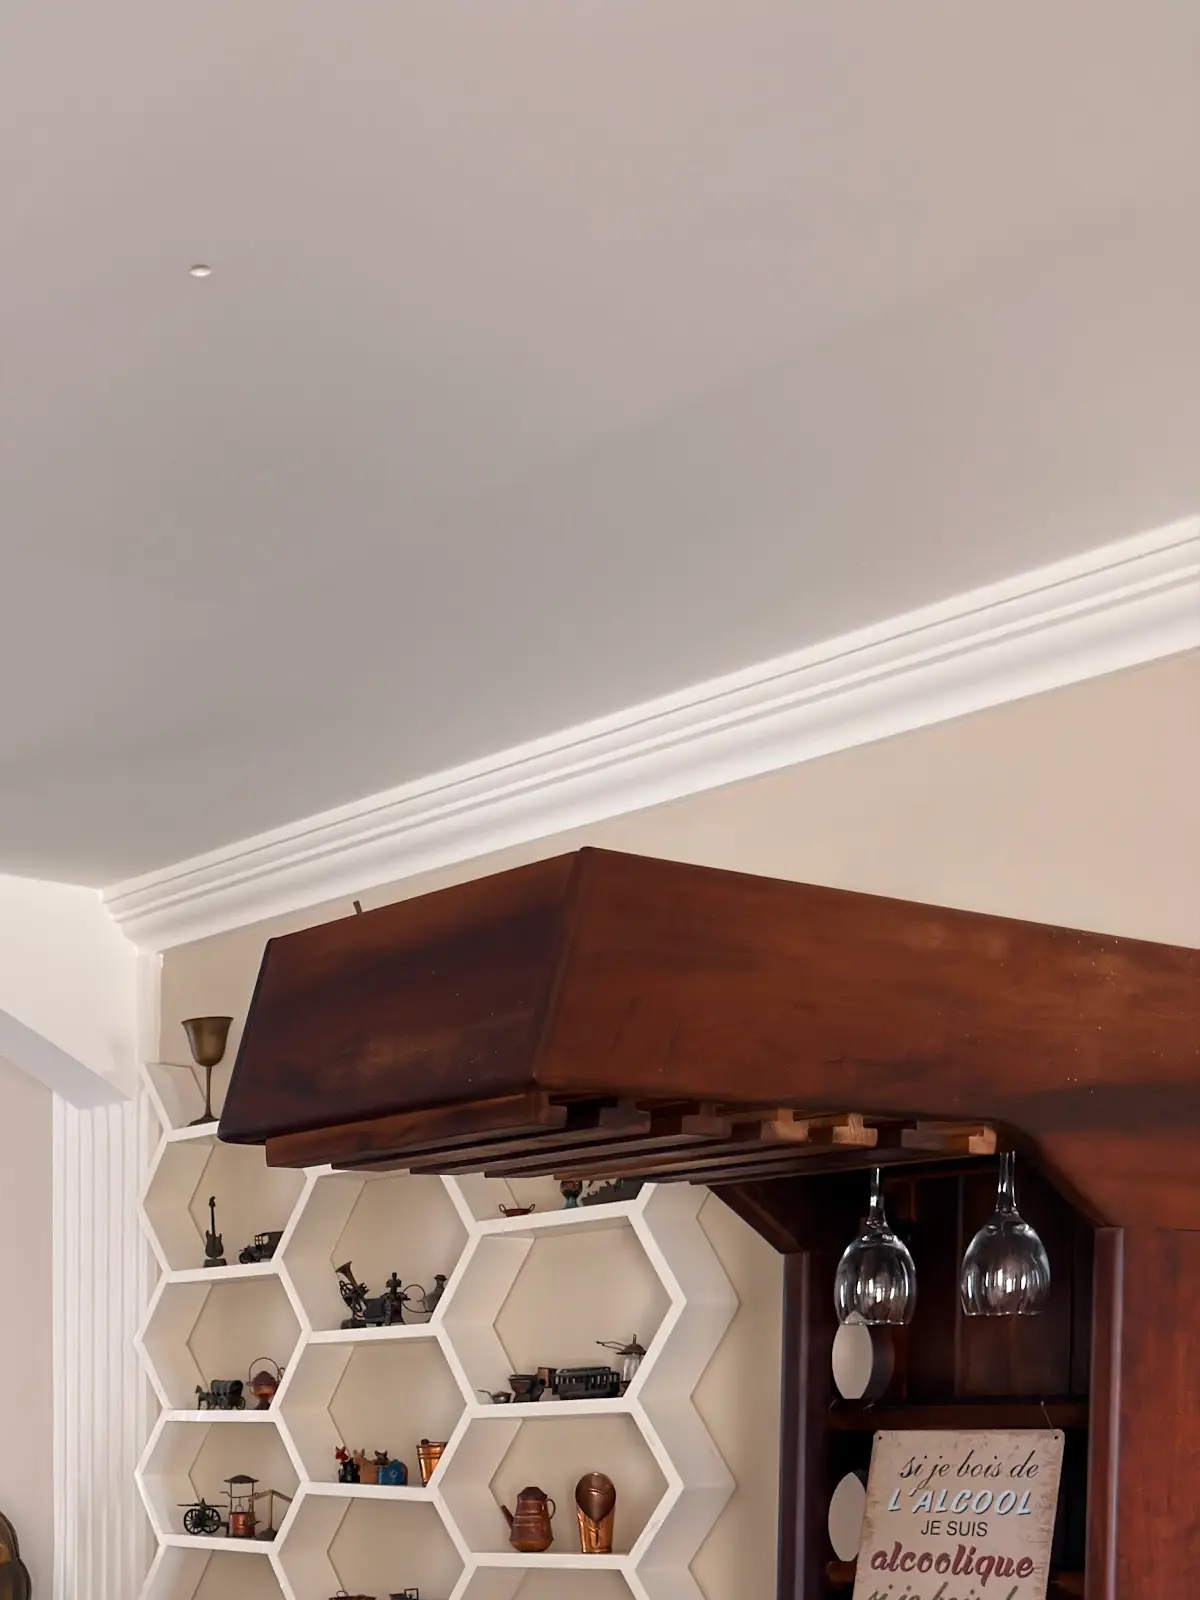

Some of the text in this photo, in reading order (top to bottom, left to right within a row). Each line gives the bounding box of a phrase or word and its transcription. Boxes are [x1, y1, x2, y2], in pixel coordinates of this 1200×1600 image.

[900, 1449, 1039, 1490] si je bois de
[887, 1487, 1032, 1516] L'ALCOOL
[921, 1520, 988, 1537] JE SUIS
[870, 1541, 1035, 1587] alcoolique
